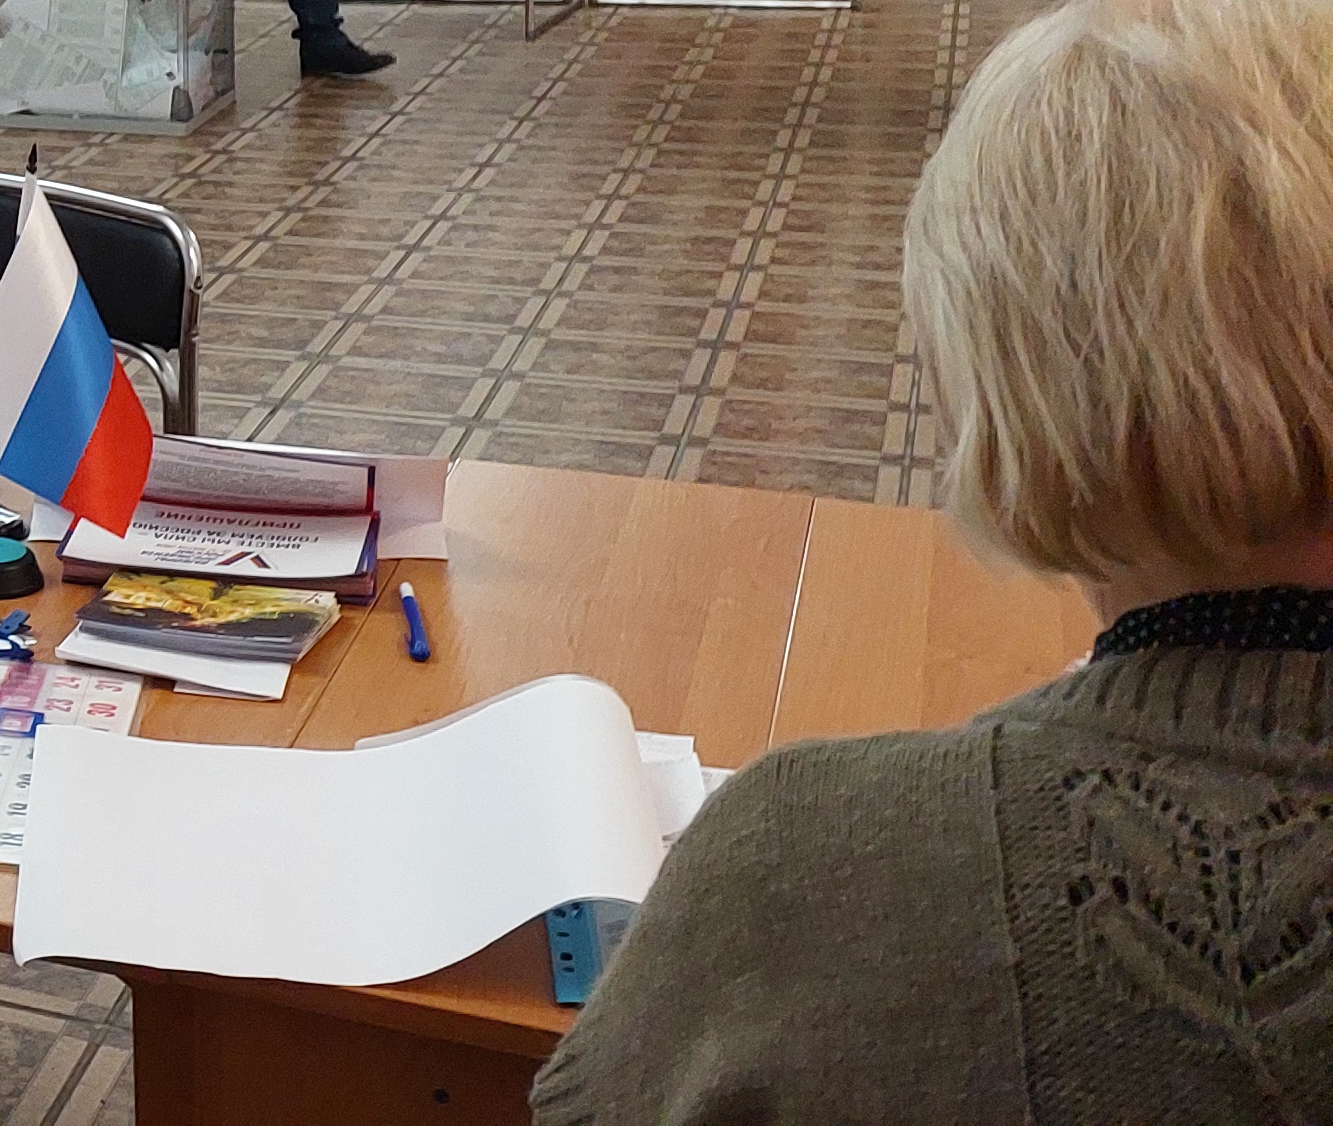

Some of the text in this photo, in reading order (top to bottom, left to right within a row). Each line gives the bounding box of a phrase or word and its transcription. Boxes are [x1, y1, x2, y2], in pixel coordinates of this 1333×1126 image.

[154, 509, 304, 530] ПРИГЛАШЕНИЕ
[133, 522, 202, 536] РОССИЮ
[154, 532, 198, 543] СИЛА
[201, 536, 232, 546] МЫ
[230, 530, 320, 543] ГОЛОСУЕМ
[236, 539, 302, 550] ВМЕСТЕ
[53, 676, 81, 689] 24
[44, 698, 74, 712] 23
[87, 680, 123, 718] 30 31
